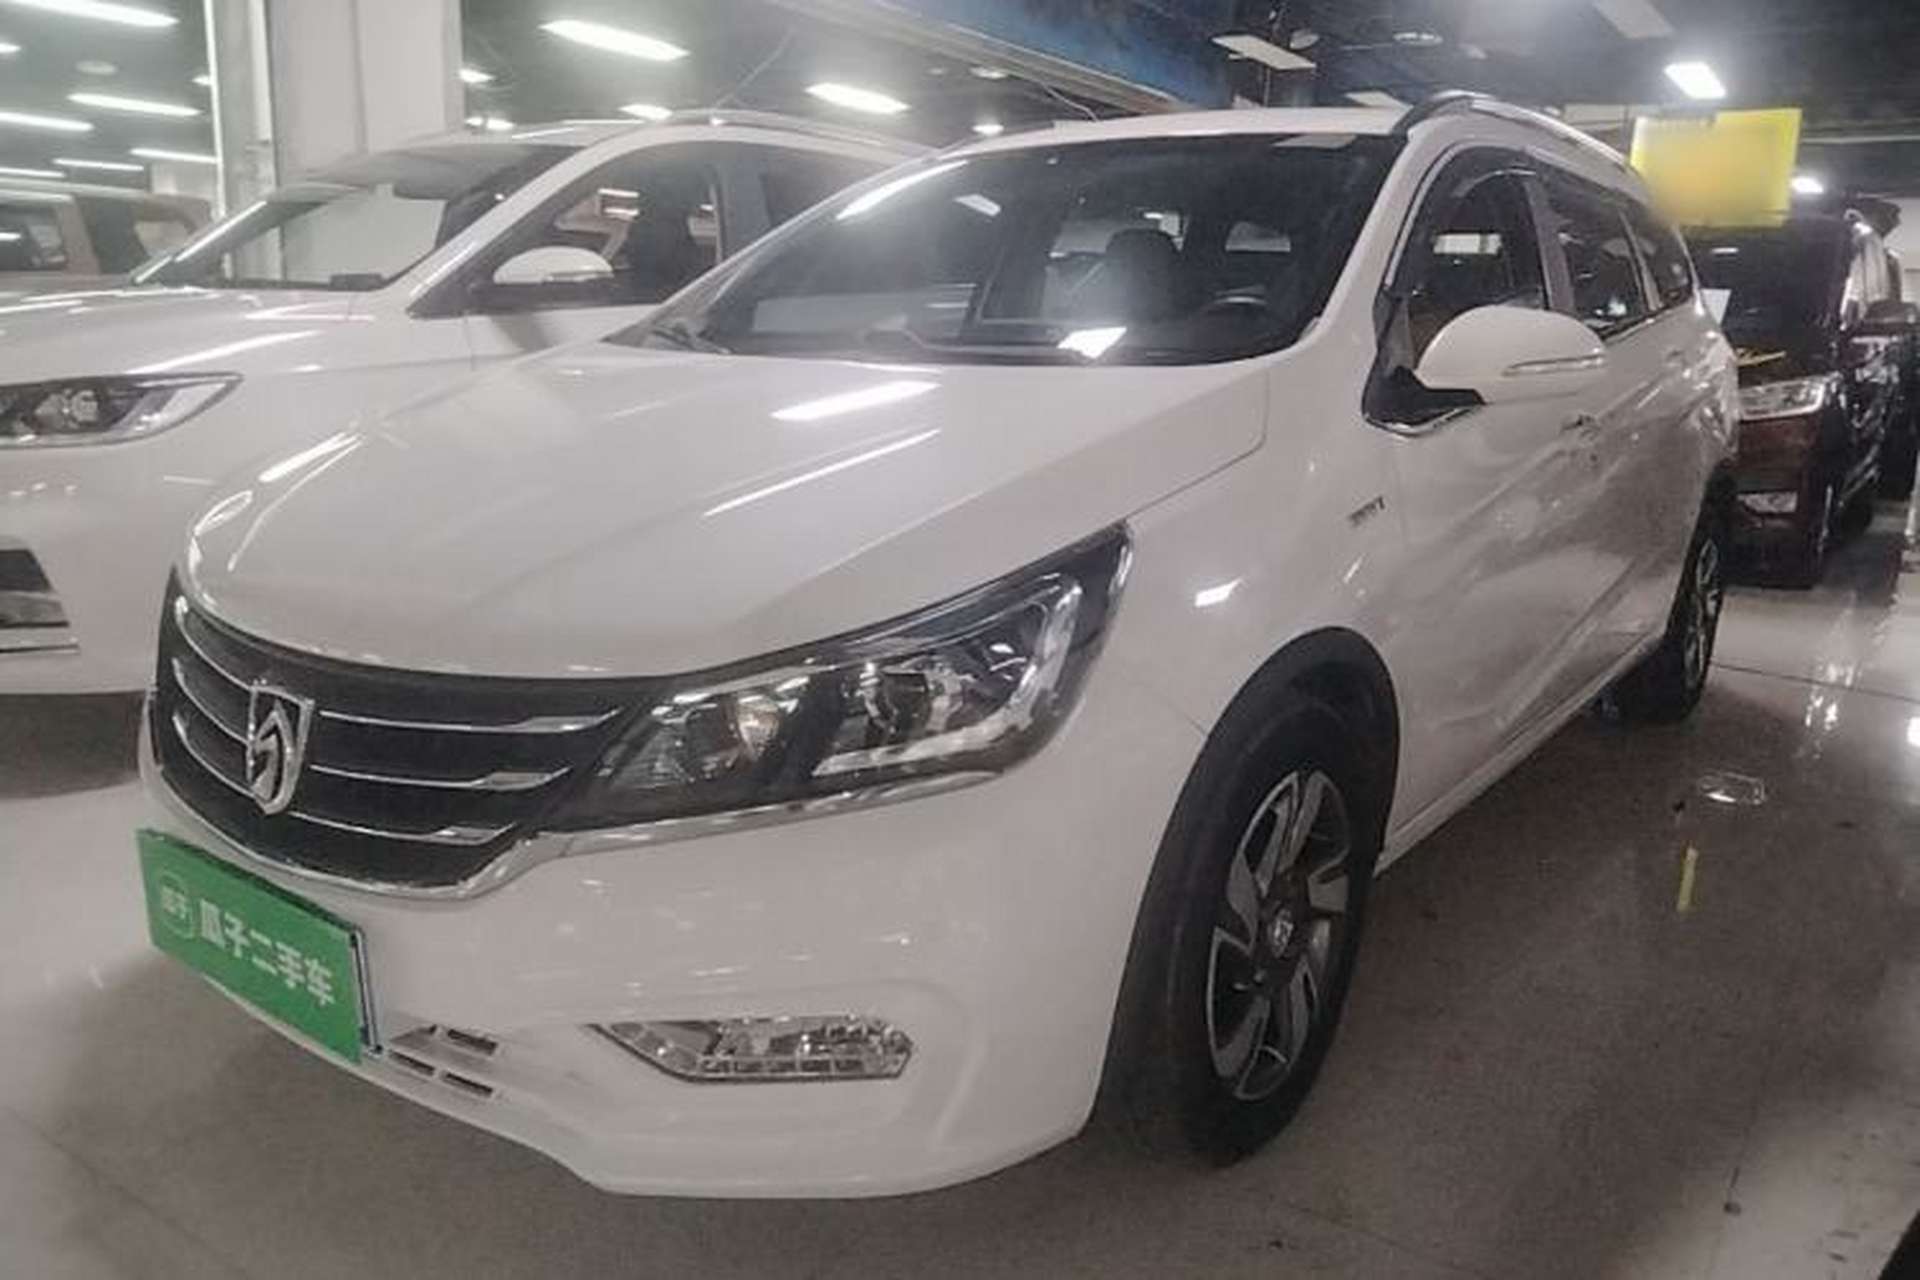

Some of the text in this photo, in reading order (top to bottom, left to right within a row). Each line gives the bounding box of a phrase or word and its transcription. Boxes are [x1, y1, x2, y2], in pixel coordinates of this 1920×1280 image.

[201, 898, 334, 1006] 瓜子二手车
